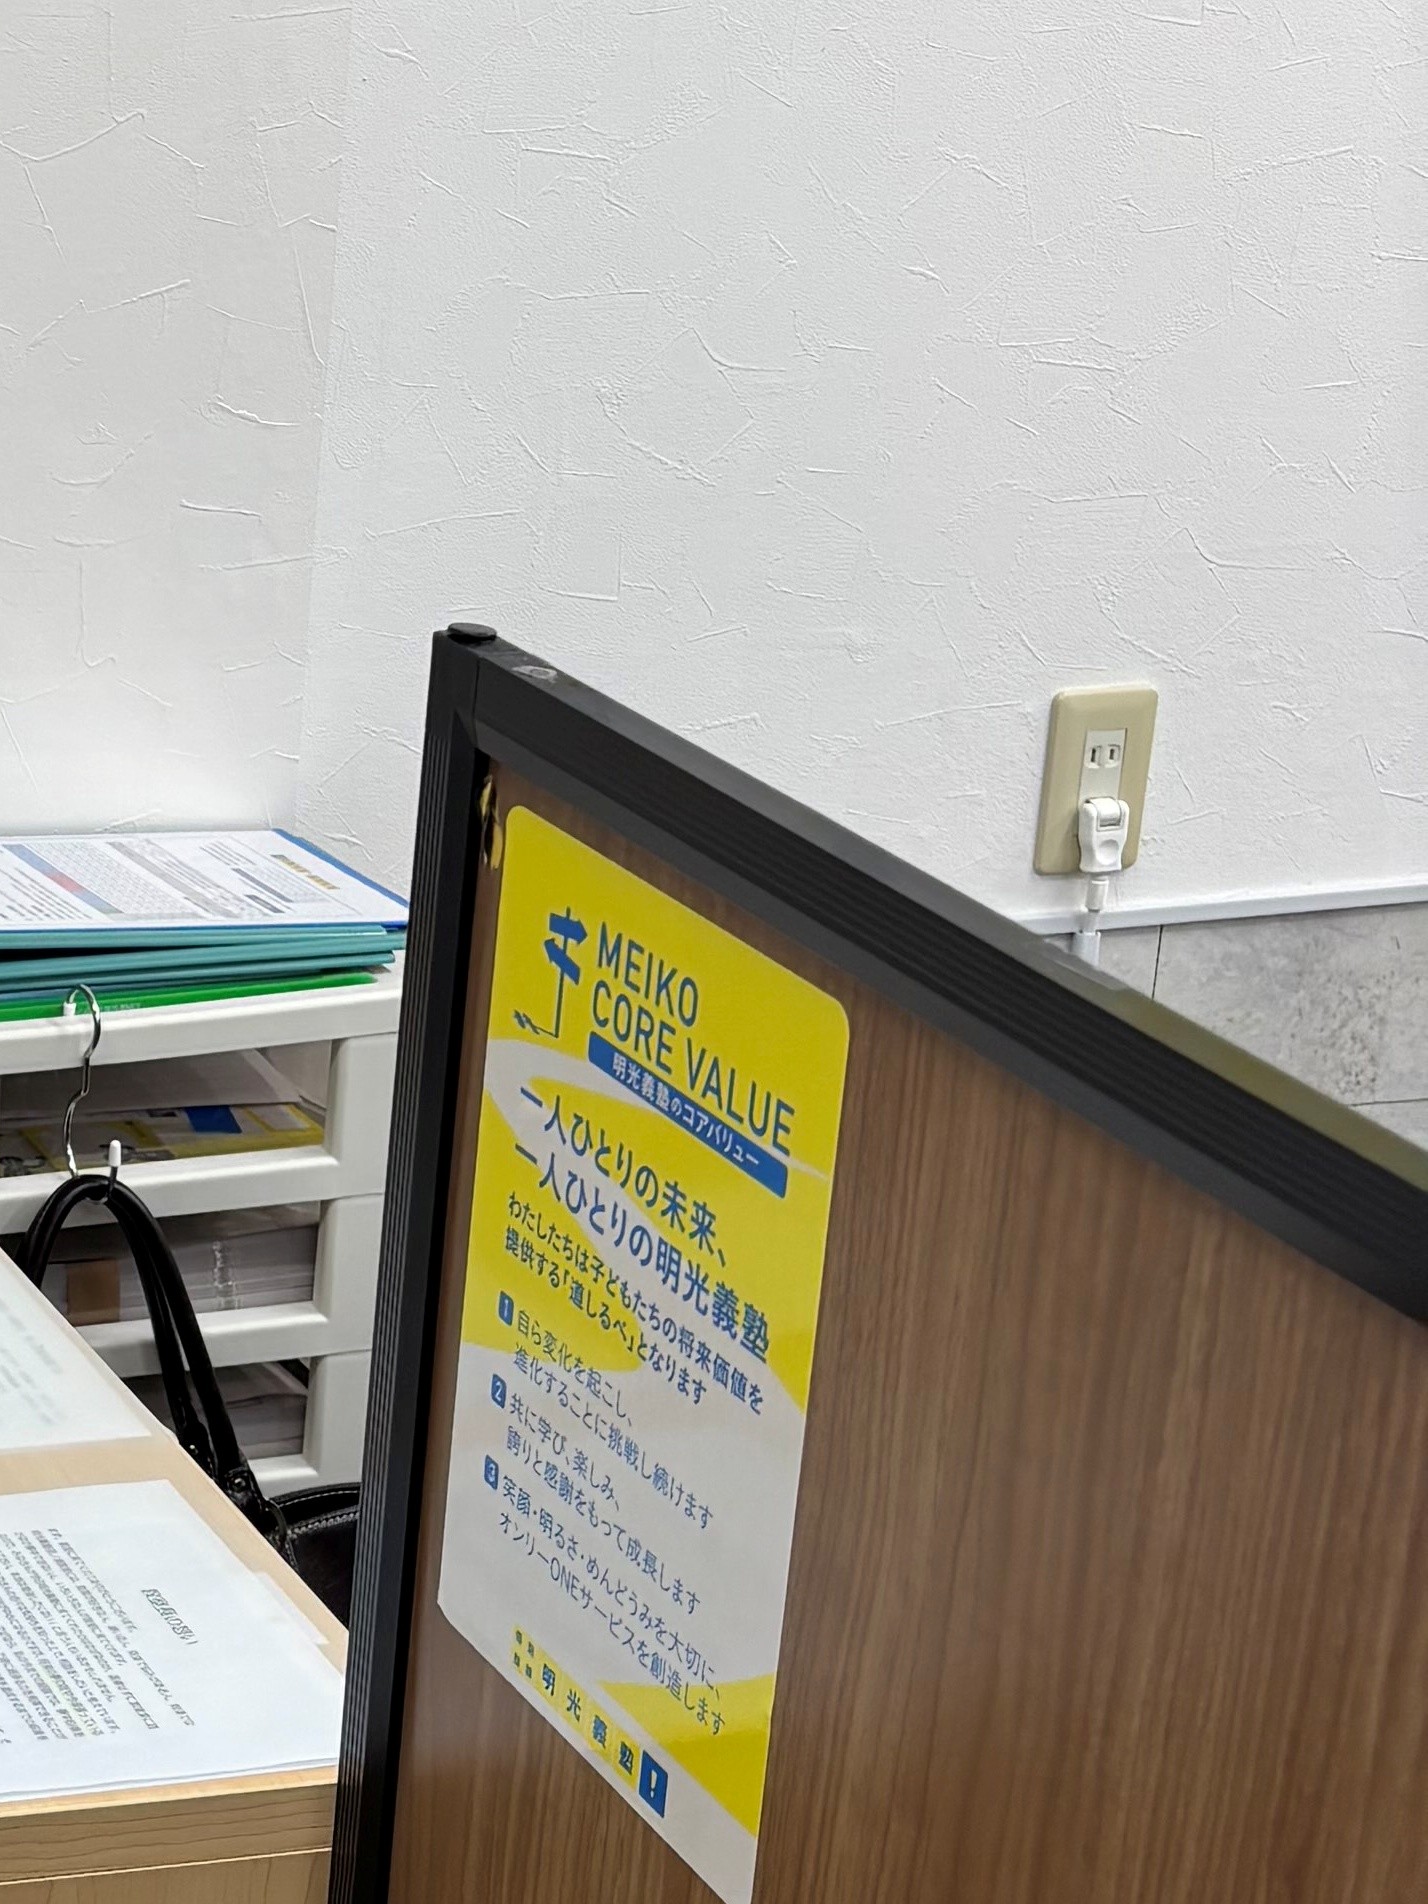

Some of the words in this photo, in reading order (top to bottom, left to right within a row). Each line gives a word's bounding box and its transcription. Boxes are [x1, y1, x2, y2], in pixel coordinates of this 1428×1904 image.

[597, 921, 699, 1028] MEIKO
[592, 979, 675, 1075] CORE
[686, 1037, 796, 1158] VALUE
[612, 1052, 760, 1167] 明光義塾のコアバリュー
[514, 1143, 770, 1364] 一人ひとりの明光義塾
[520, 1086, 728, 1268] 一人ひとりの未来、
[505, 1227, 707, 1405] 提供する「道しるべ」となります
[507, 1193, 764, 1415] わたしたちは子どもたちの将来価値を
[518, 1309, 634, 1427] 自ら変化を起こし、
[506, 1425, 701, 1612] 誇りと感謝をもって成長します
[509, 1393, 621, 1513] 共に学び、楽しみ、
[513, 1342, 714, 1531] 進化することに挑戦し続けます
[500, 1511, 727, 1737] オンリーONEサービスを創造します
[502, 1474, 721, 1700] 笑顔・明るさ・めんどうみを大切に、
